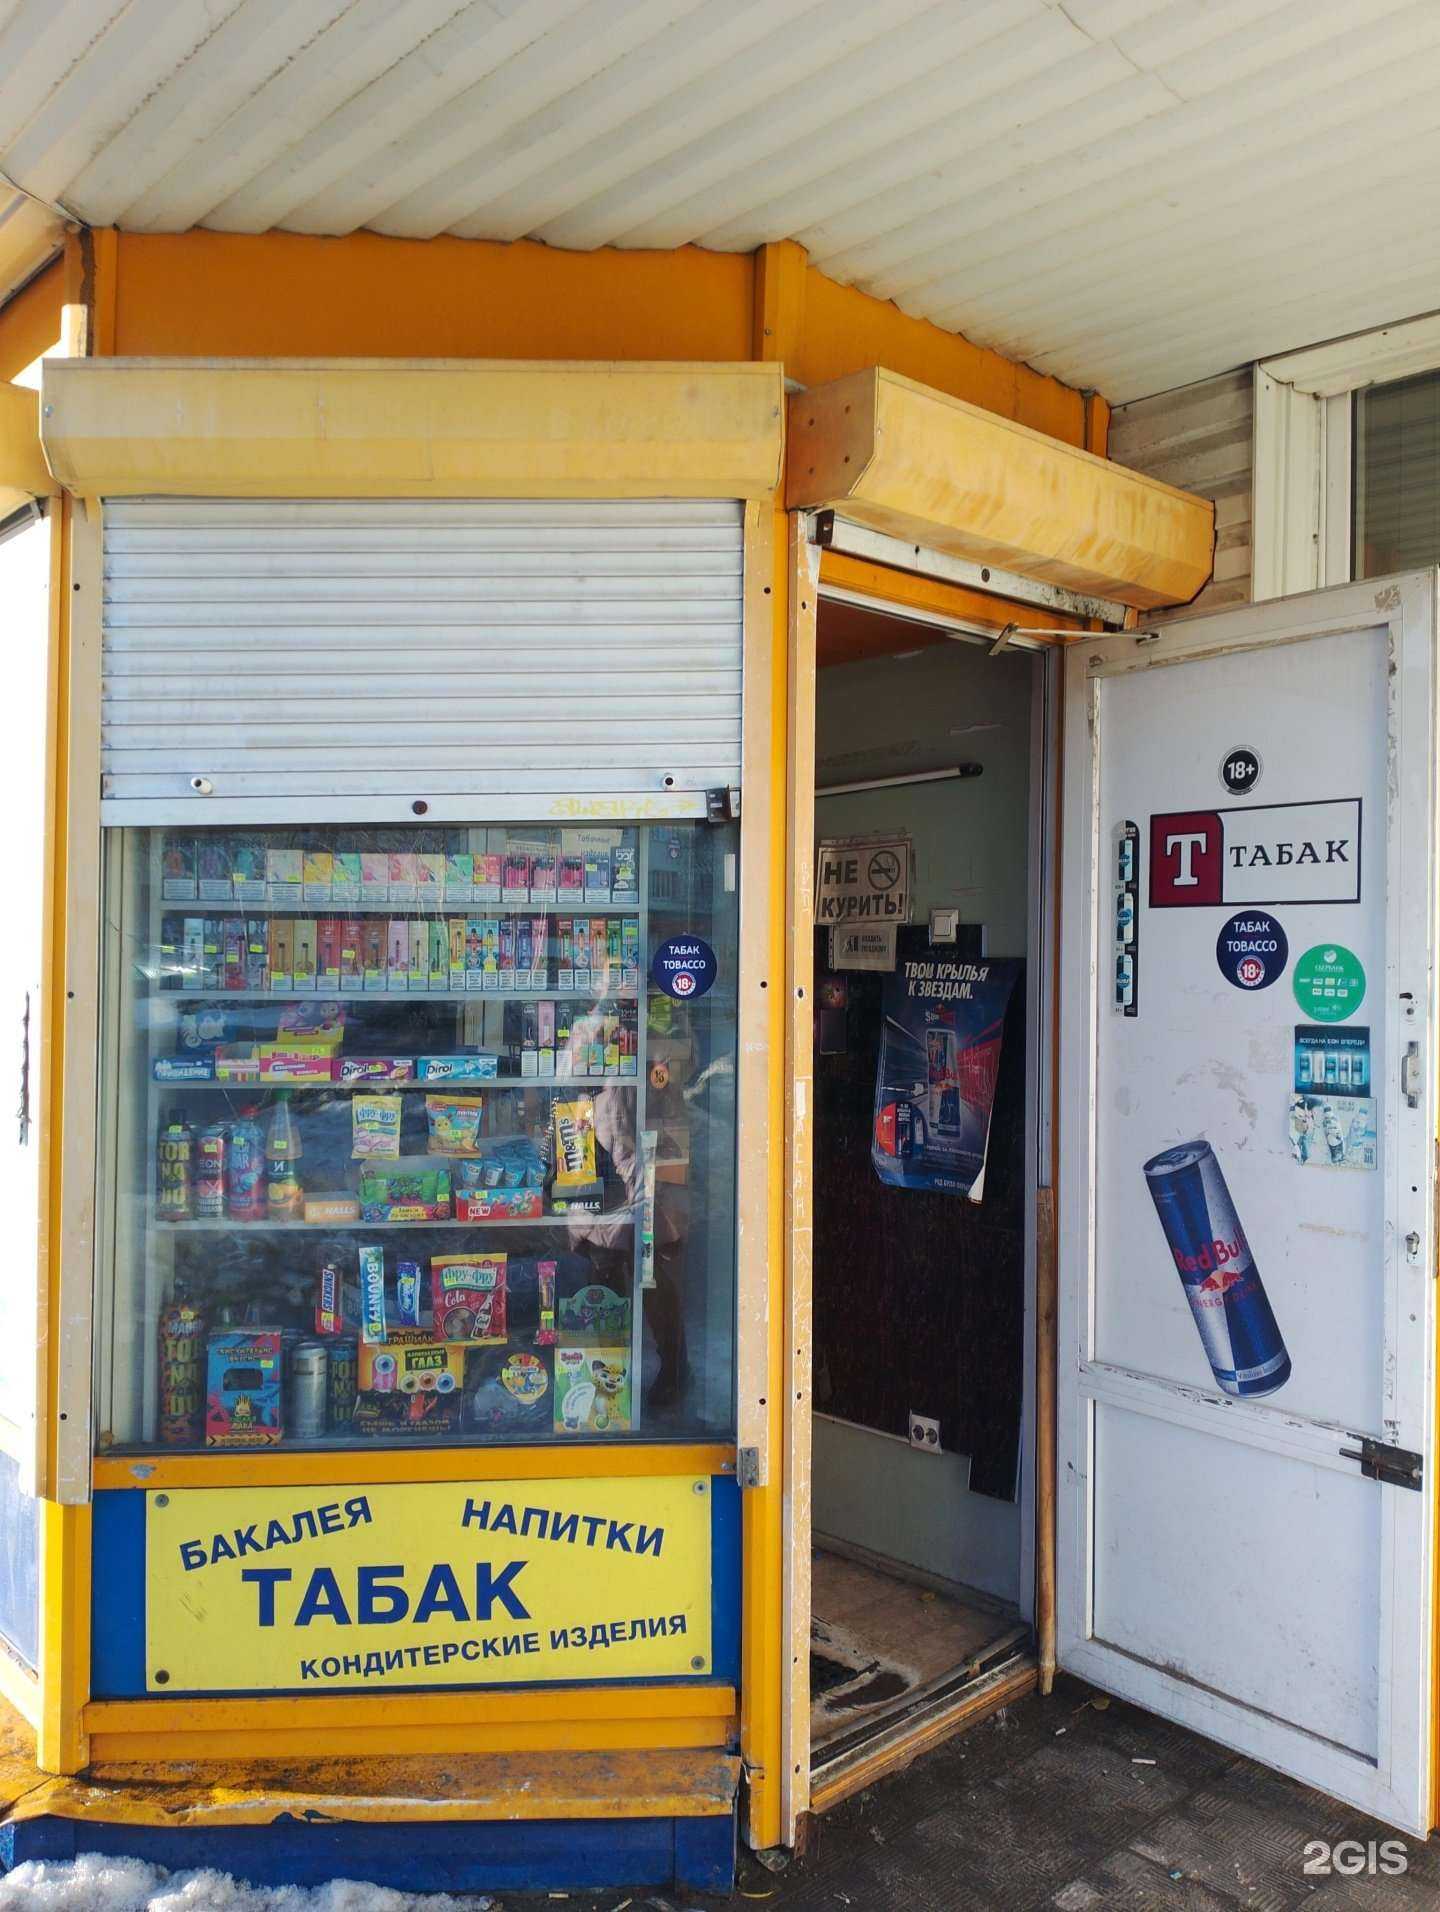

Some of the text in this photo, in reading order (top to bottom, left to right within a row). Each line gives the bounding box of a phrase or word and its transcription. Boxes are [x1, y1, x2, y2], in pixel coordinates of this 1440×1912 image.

[1227, 762, 1255, 779] 18+
[1165, 833, 1207, 886] Т
[1230, 840, 1349, 867] ТАБАК
[824, 860, 858, 886] НЕ
[821, 893, 905, 918] КУРИТЬ!
[1233, 921, 1270, 934] ТАБАК
[669, 945, 700, 956] ТАБАК
[1227, 940, 1277, 953] TOBACCO
[663, 959, 706, 970] TOBACCO
[904, 961, 990, 983] ТВОИ КРЫЛЬЯ
[1242, 963, 1260, 978] 18+
[676, 977, 691, 989] 18+
[908, 981, 974, 1000] К ЗВЕЗДАМ.
[342, 1064, 368, 1077] Dirol
[427, 1063, 453, 1075] Dirol
[468, 1206, 489, 1216] NEW
[570, 1201, 600, 1210] HALLS
[1174, 1230, 1246, 1273] Red Bull
[367, 1262, 382, 1321] BOUNTY
[444, 1294, 466, 1307] Cola
[179, 1496, 664, 1571] БАКАЛЕЯ НАПИТКИ
[242, 1561, 531, 1628] ТАБАК
[300, 1614, 688, 1680] КОНДИТЕРСКИЕ ИЗДЕЛИЯ
